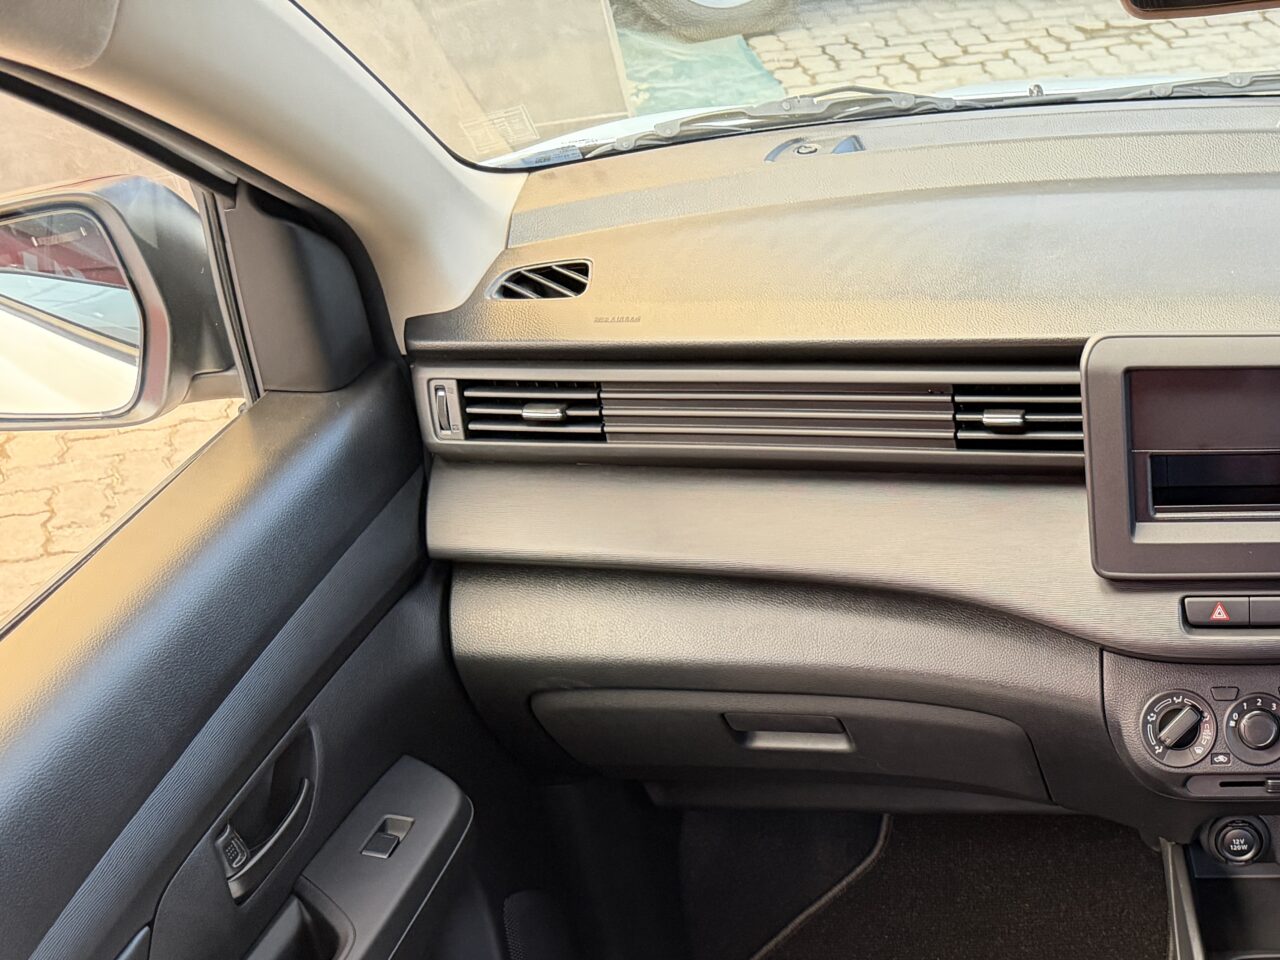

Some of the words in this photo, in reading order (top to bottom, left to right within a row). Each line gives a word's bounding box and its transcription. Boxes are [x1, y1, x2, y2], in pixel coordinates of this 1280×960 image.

[1243, 702, 1247, 710] 1
[1256, 698, 1262, 706] 2
[1271, 703, 1277, 711] 3
[1232, 712, 1239, 720] 0
